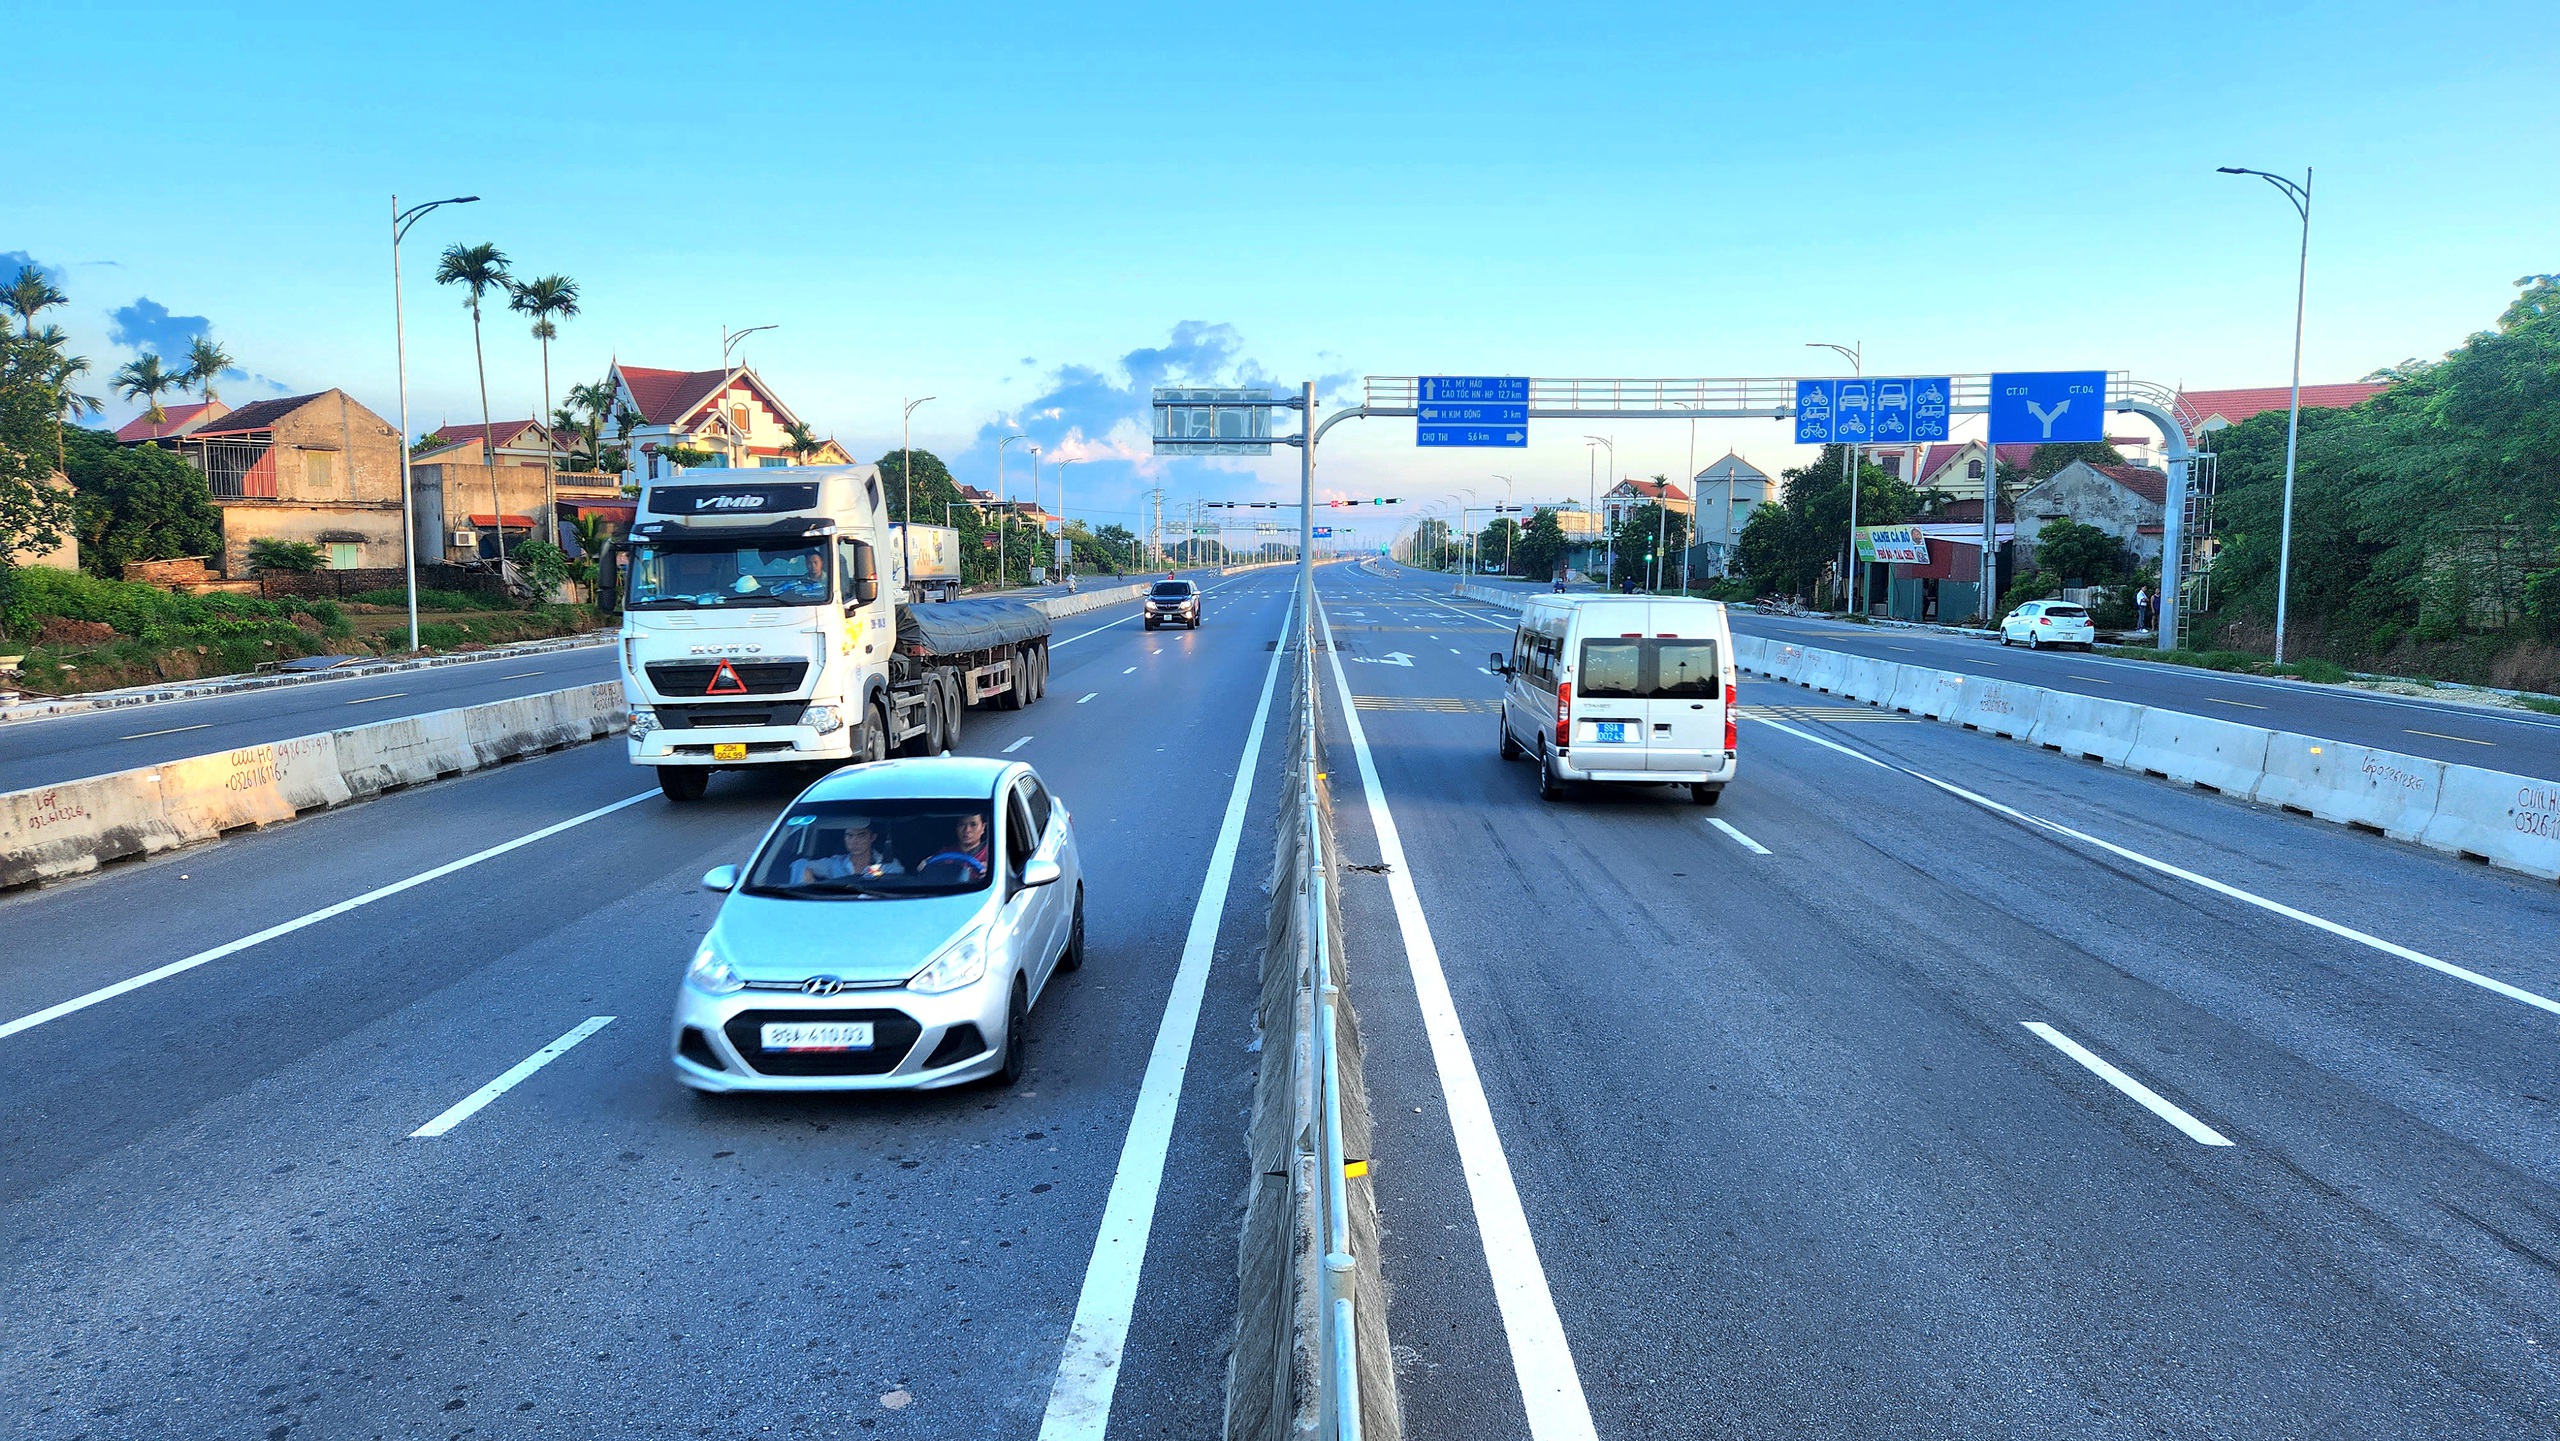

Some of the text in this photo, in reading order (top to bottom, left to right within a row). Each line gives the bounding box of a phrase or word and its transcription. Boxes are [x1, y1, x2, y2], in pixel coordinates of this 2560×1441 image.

[1498, 379, 1507, 389] 24
[1511, 379, 1522, 389] km
[1441, 389, 1455, 398] CAO
[1498, 390, 1511, 400] 12,7
[1511, 390, 1522, 399] km
[2006, 387, 2029, 396] CT.01
[2069, 385, 2094, 394] CT.04
[1503, 409, 1508, 419] 3
[1510, 410, 1522, 419] km
[1478, 431, 1490, 441] km
[1872, 530, 1891, 543] CANH
